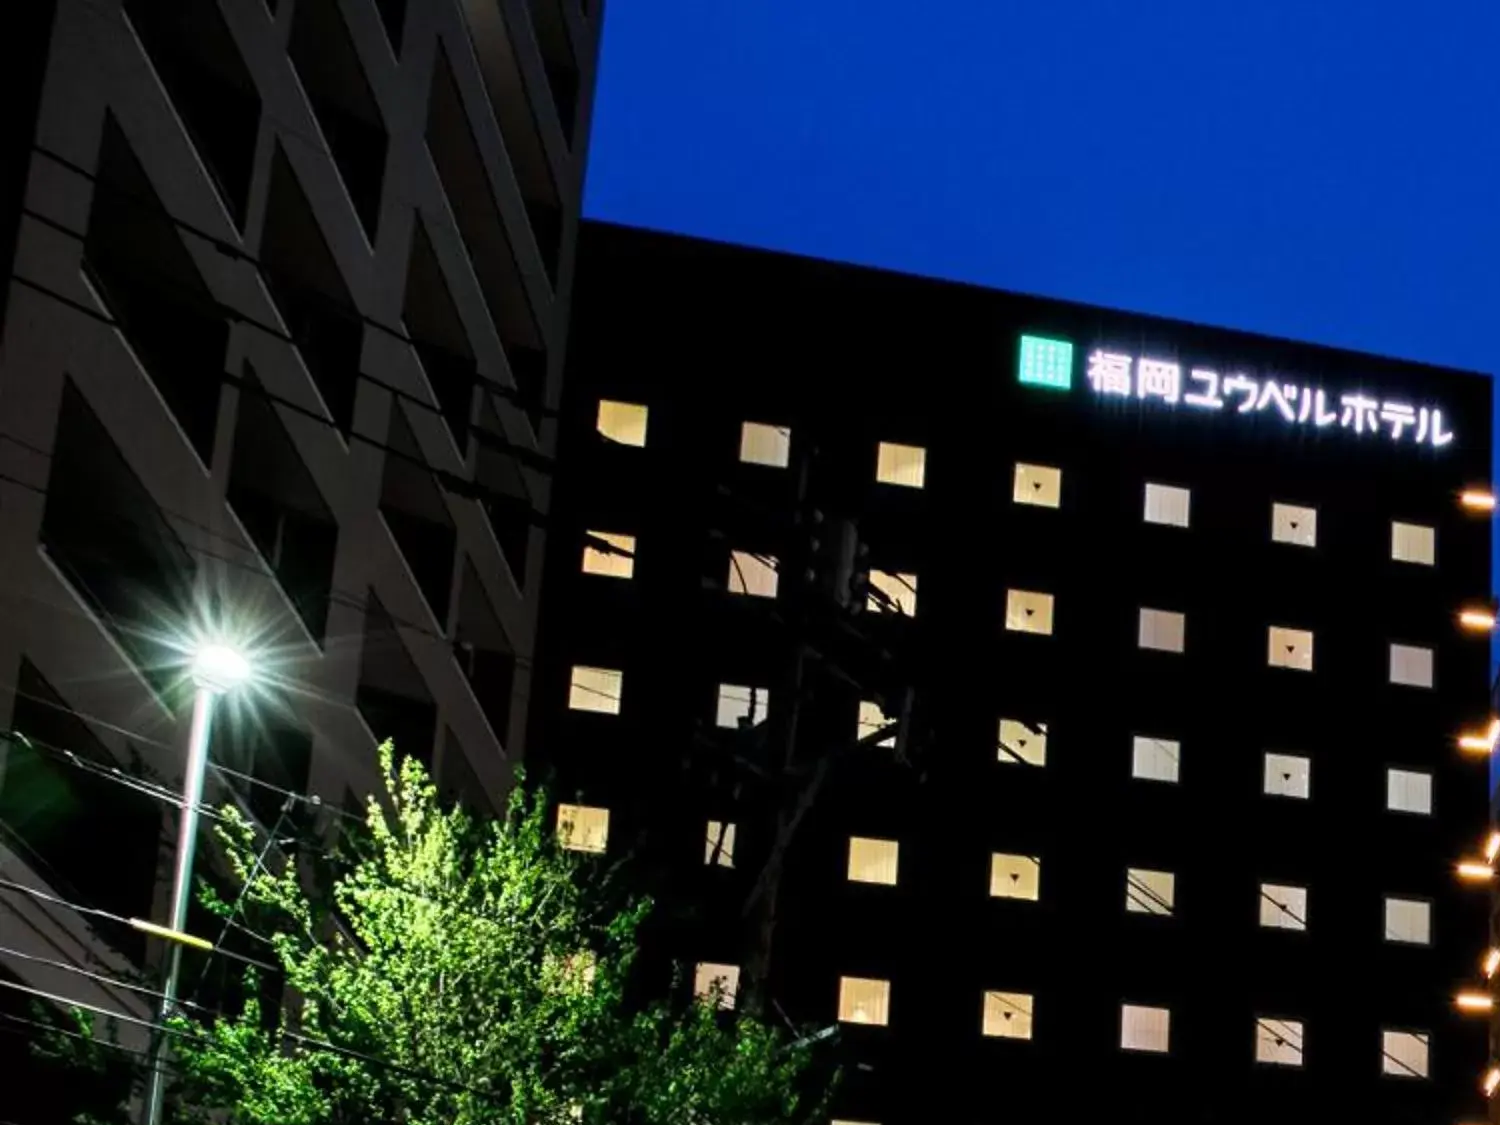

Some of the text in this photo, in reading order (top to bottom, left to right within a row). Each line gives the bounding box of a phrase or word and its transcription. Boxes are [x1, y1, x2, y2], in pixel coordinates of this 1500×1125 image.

[1088, 349, 1454, 446] 福岡ユウベルホテル
